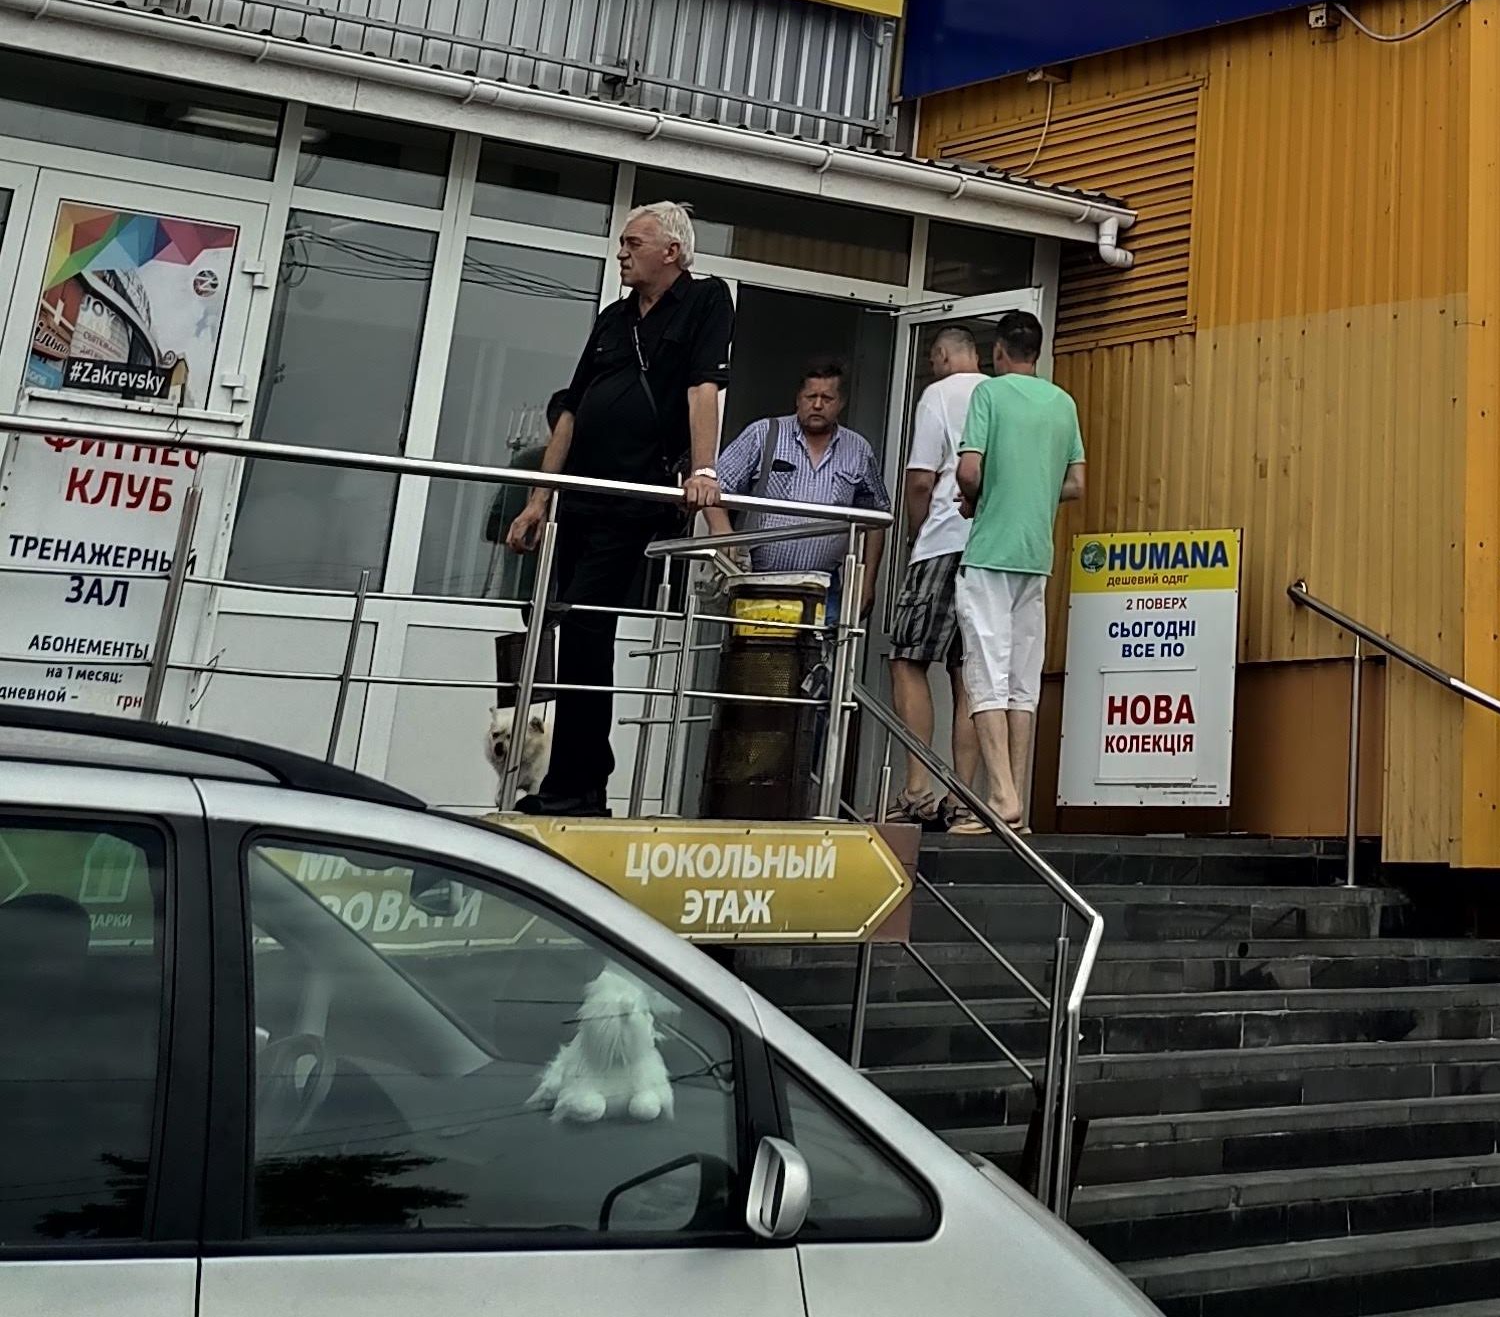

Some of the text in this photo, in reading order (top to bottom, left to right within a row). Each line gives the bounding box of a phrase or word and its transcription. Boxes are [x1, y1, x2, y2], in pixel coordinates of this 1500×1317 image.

[69, 360, 166, 397] #Zakrevsky
[65, 466, 174, 513] КЛУБ
[1107, 540, 1229, 572] HUMANA
[65, 574, 130, 608] ЗАЛ
[1107, 572, 1189, 588] дешевий одяг
[1126, 597, 1188, 610] 2 ПОВЕРХ
[1108, 620, 1196, 640] СЬОГОДНІ
[28, 634, 150, 661] АБОНЕМЕНТЫ
[1121, 641, 1185, 658] ВСЕ ПО
[46, 665, 124, 685] на 1 месяц:
[117, 694, 143, 711] грн
[1107, 694, 1196, 725] НОВА
[1104, 733, 1194, 756] КОЛЕКЦІЯ
[624, 837, 837, 886] ЦОКОЛЬНЫЙ
[680, 890, 775, 925] ЭТАЖ
